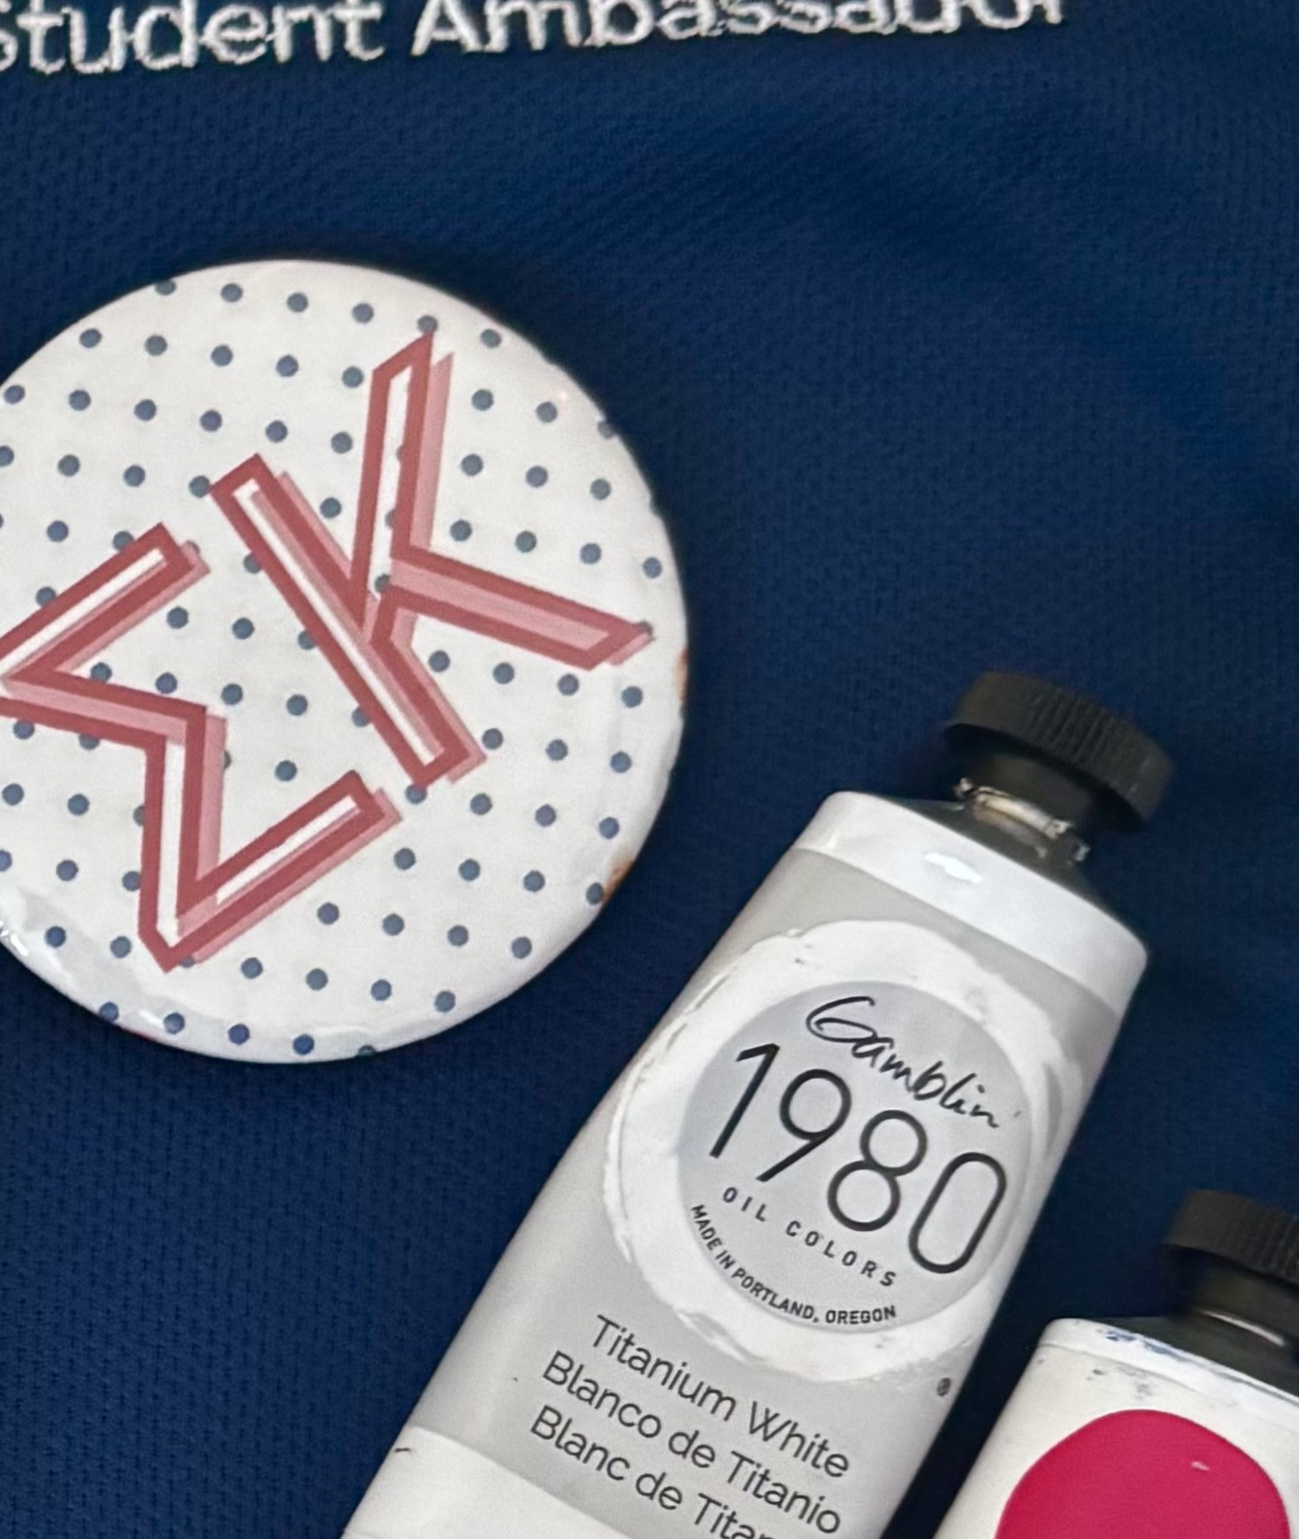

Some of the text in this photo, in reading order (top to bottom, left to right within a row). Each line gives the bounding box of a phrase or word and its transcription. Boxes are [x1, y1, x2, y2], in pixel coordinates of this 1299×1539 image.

[805, 995, 999, 1130] Gamblin
[709, 1042, 1007, 1275] 1980
[691, 1204, 897, 1325] MADE IN PORTLAND, OREGON
[722, 1187, 896, 1287] OIL COLORS
[530, 1404, 631, 1482] Blanc
[635, 1471, 683, 1511] de
[543, 1350, 841, 1534] Blanco de Titanio
[592, 1314, 850, 1478] Titanium White
